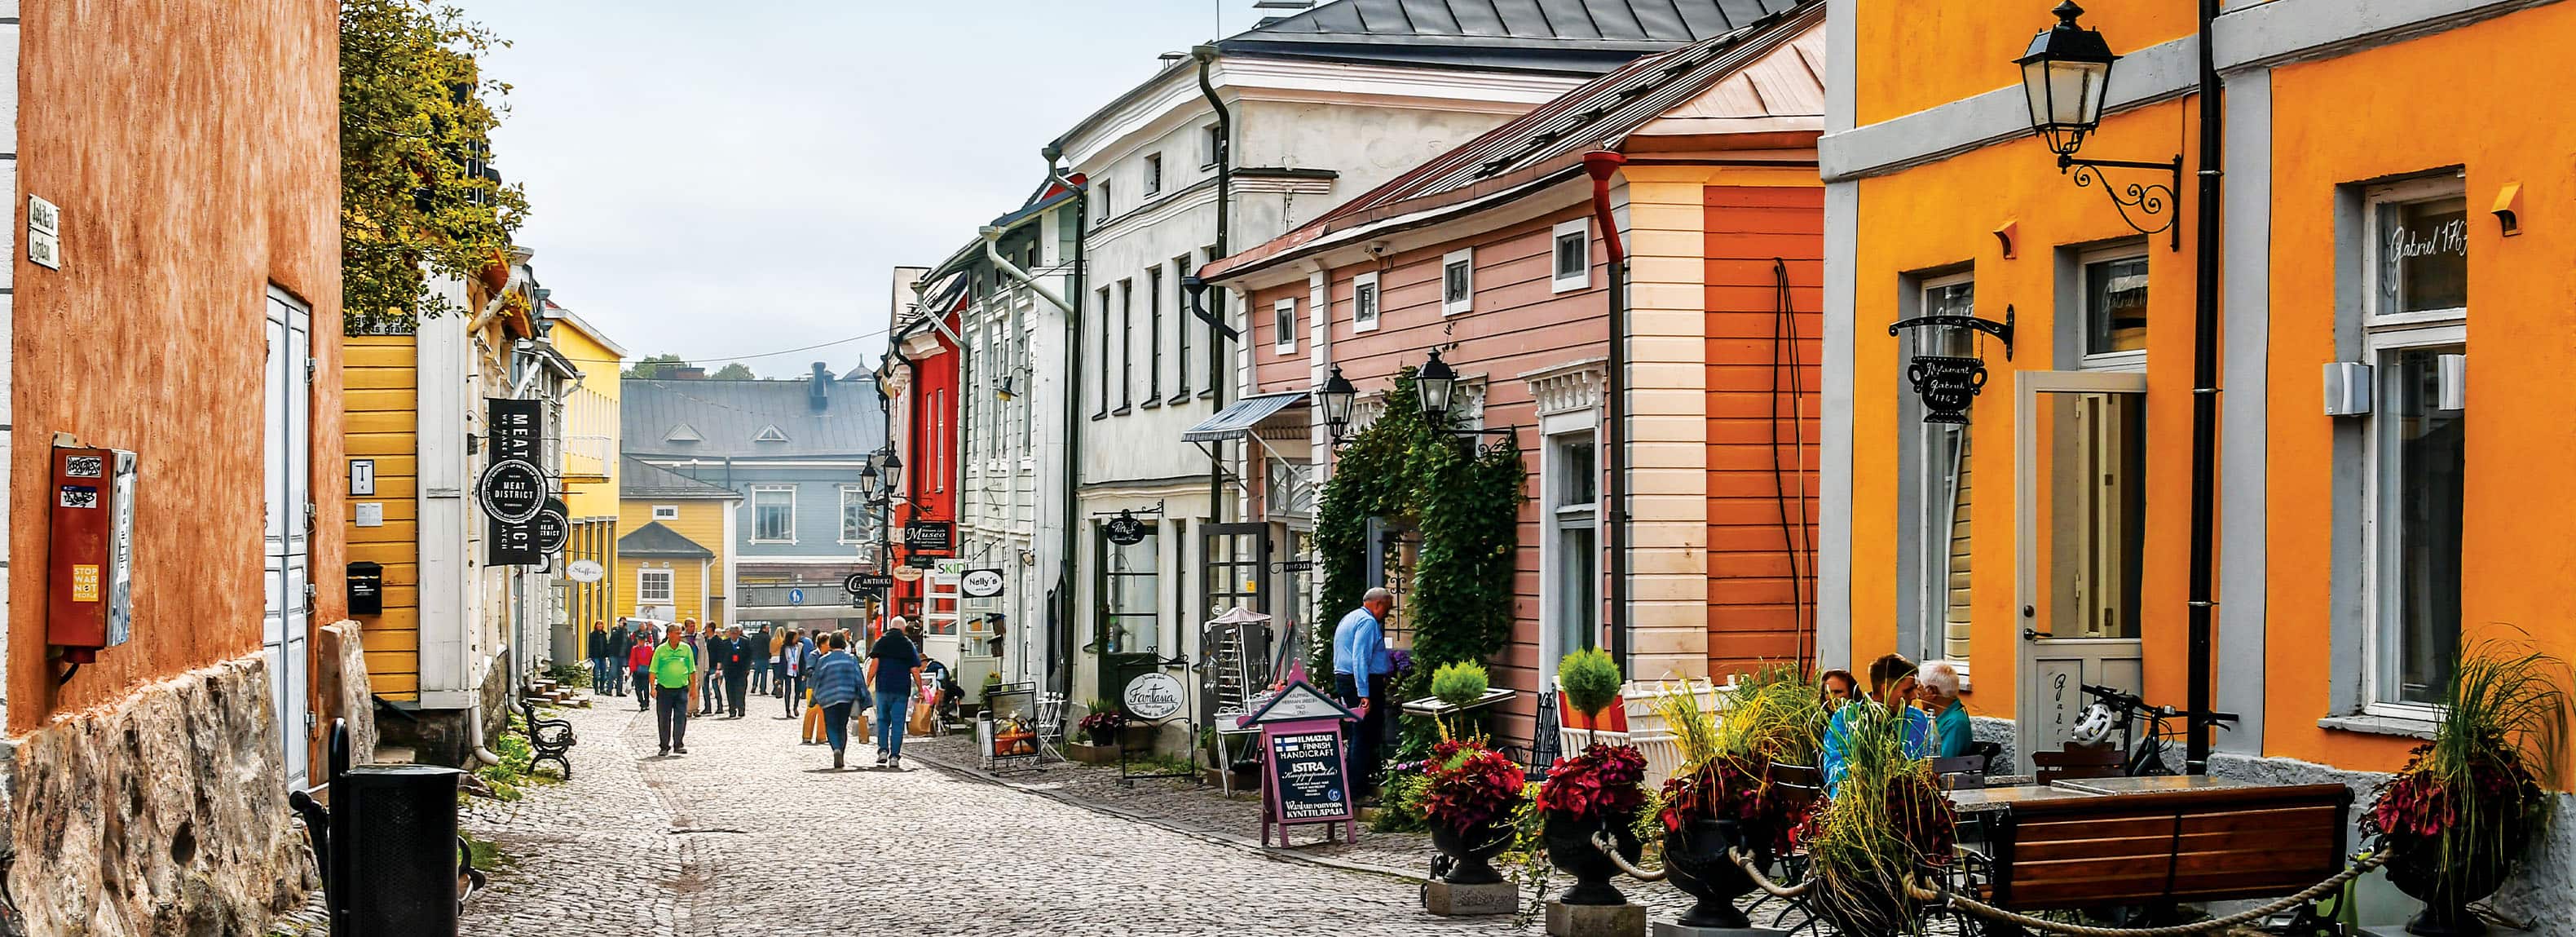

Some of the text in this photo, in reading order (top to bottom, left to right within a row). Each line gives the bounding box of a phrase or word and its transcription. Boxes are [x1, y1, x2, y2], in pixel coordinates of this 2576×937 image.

[2390, 226, 2438, 291] Gabriel
[1930, 379, 1965, 397] Gabriel
[1935, 394, 1958, 404] 1763
[513, 413, 528, 457] MEAT
[504, 481, 525, 490] MEAT
[495, 490, 533, 499] DISTRICT
[75, 575, 97, 583] WAR
[75, 584, 97, 592] NOT
[1129, 678, 1175, 703] Fantasia
[2054, 674, 2067, 748] Gabri
[1297, 734, 1334, 743] ILMATAR
[1280, 749, 1334, 759] HANDICRAFT
[1292, 761, 1327, 773] ISTRA
